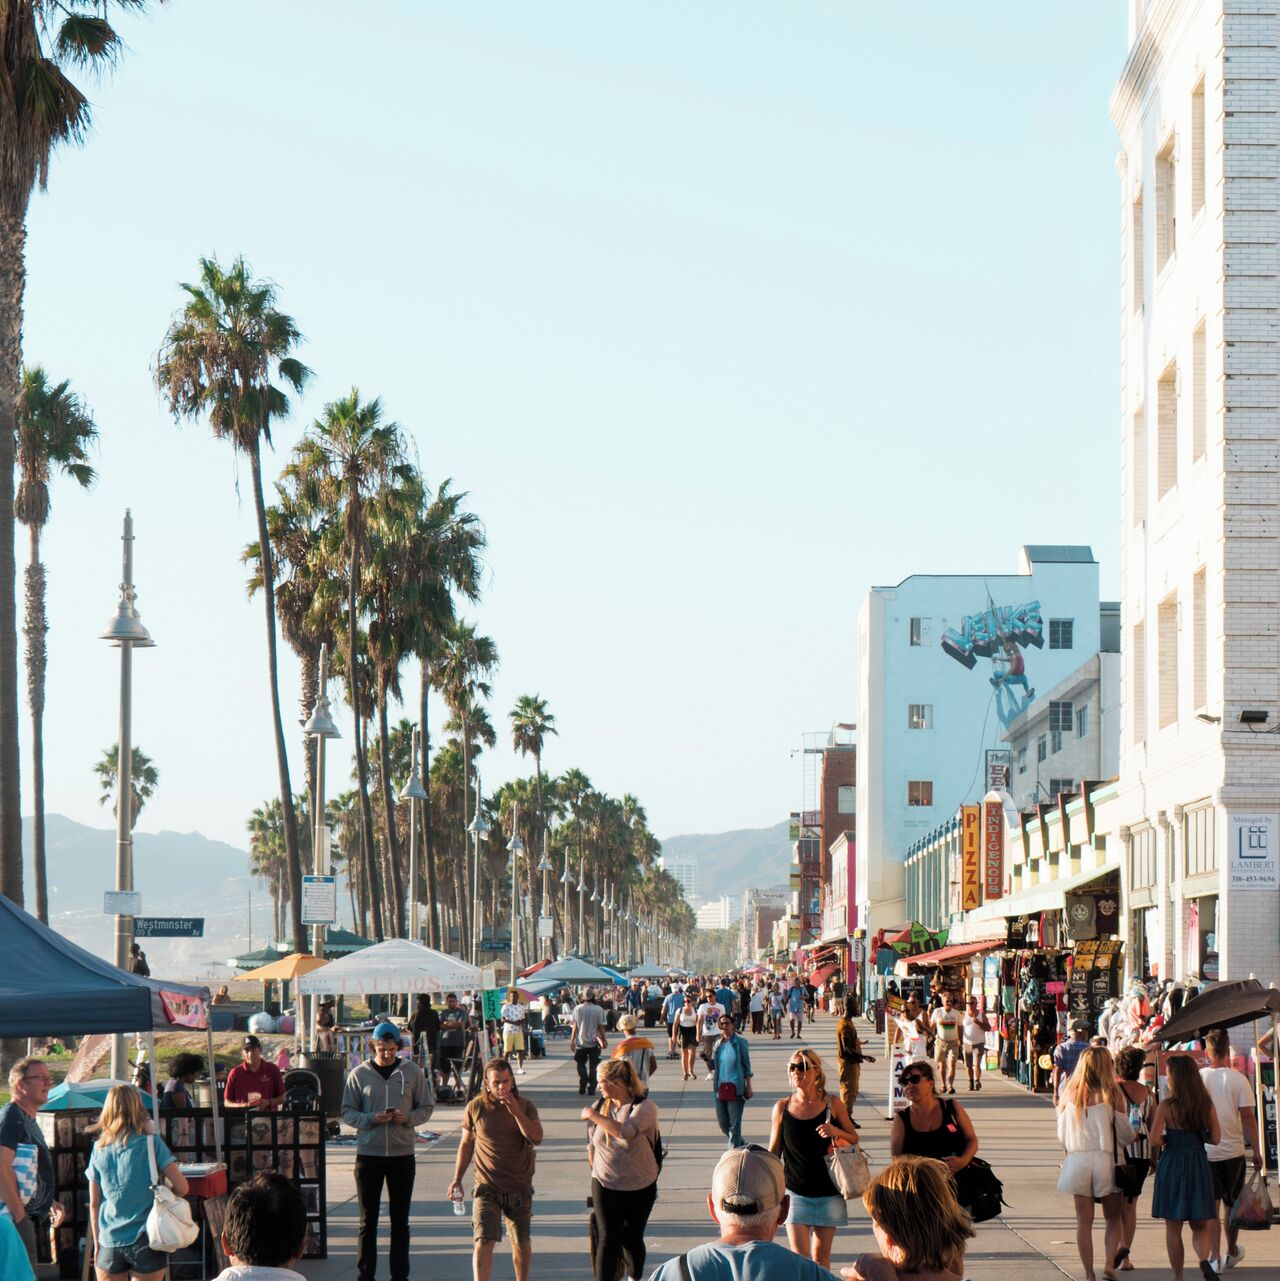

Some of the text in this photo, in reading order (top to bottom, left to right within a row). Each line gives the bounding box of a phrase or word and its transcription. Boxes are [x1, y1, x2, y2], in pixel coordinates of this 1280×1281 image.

[987, 806, 1000, 894] INDIGENOUS
[966, 813, 977, 904] PIZZA
[1231, 861, 1276, 869] LAMBERT
[136, 920, 193, 929] Westminster
[338, 976, 441, 992] TATTOOS
